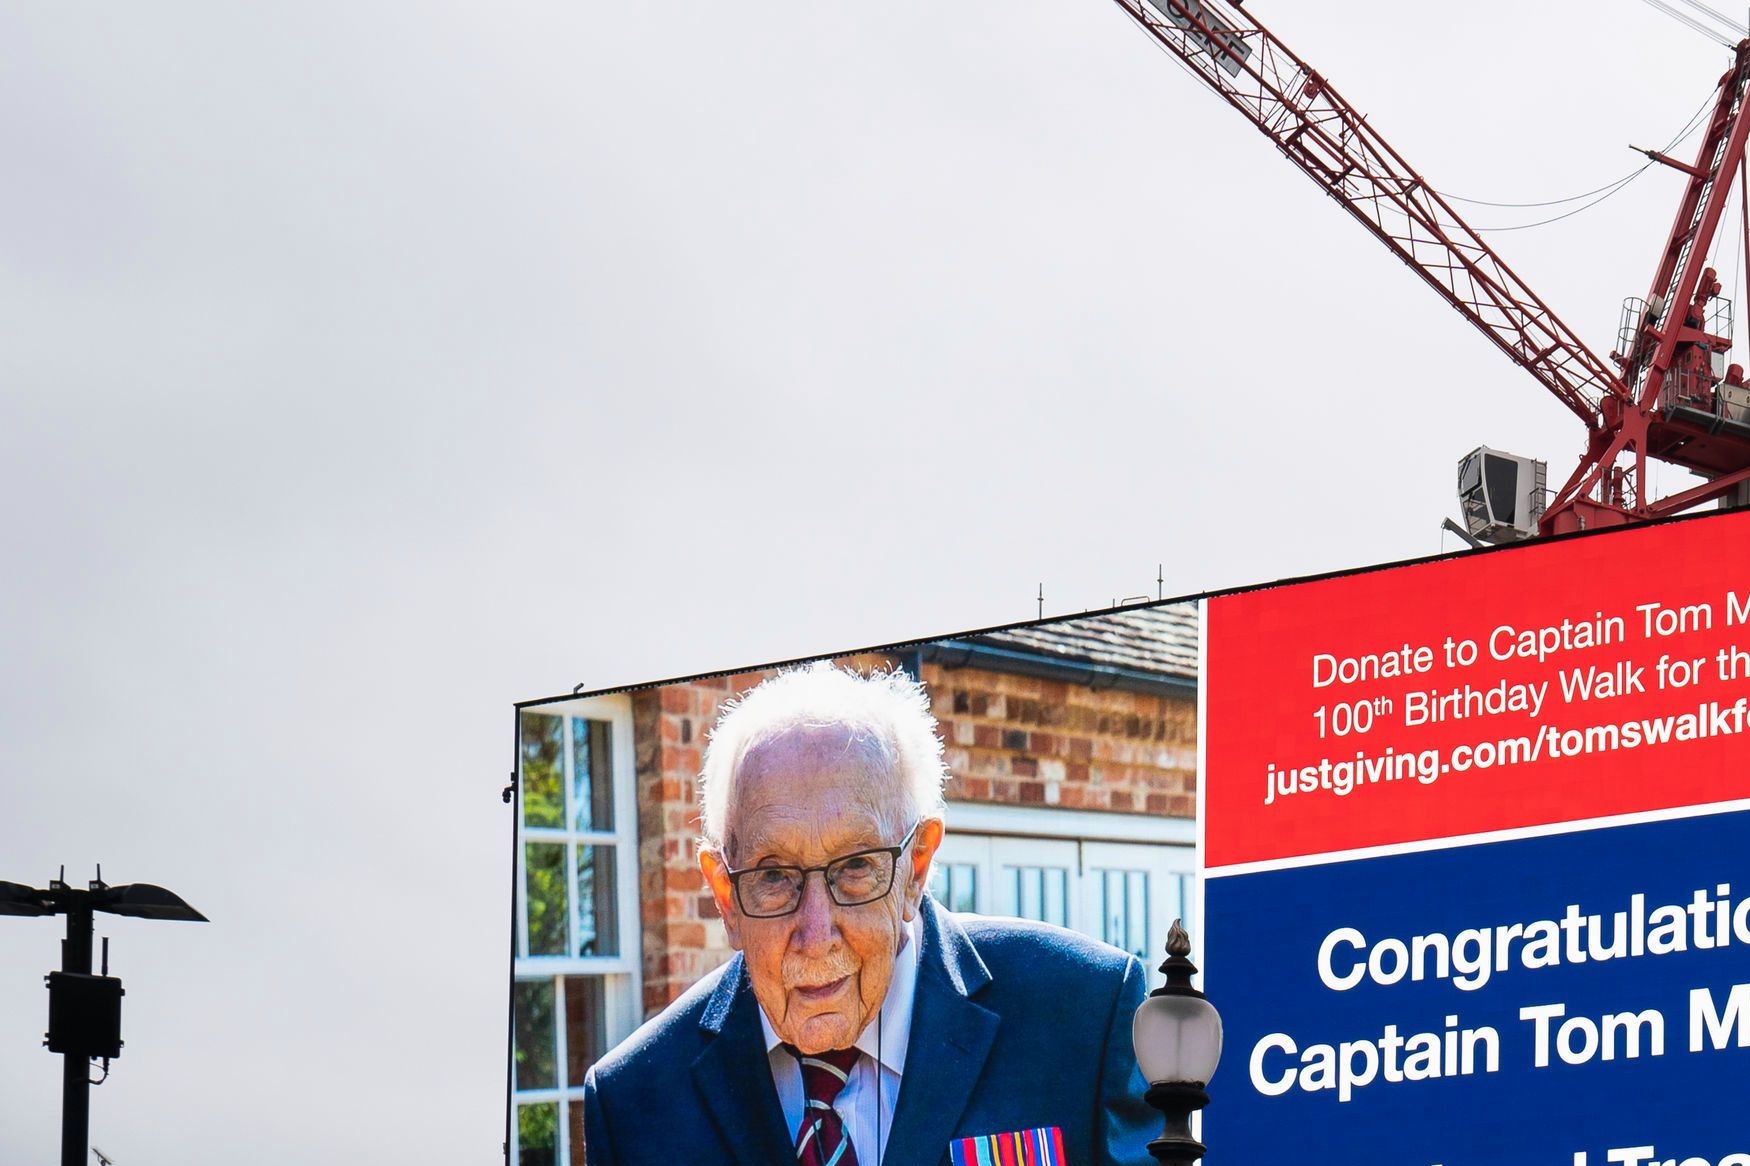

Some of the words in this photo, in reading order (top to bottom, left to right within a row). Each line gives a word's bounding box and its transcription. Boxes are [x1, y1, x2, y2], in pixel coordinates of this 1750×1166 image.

[1314, 644, 1433, 688] Donate
[1444, 637, 1477, 667] to
[1490, 612, 1623, 662] Captain
[1637, 603, 1711, 637] Tom
[1314, 696, 1392, 737] 100th
[1406, 680, 1548, 726] Birthday
[1559, 661, 1645, 702] Walk
[1656, 655, 1705, 689] for
[1250, 1015, 1499, 1102] Captain
[1520, 1004, 1664, 1067] Tom
